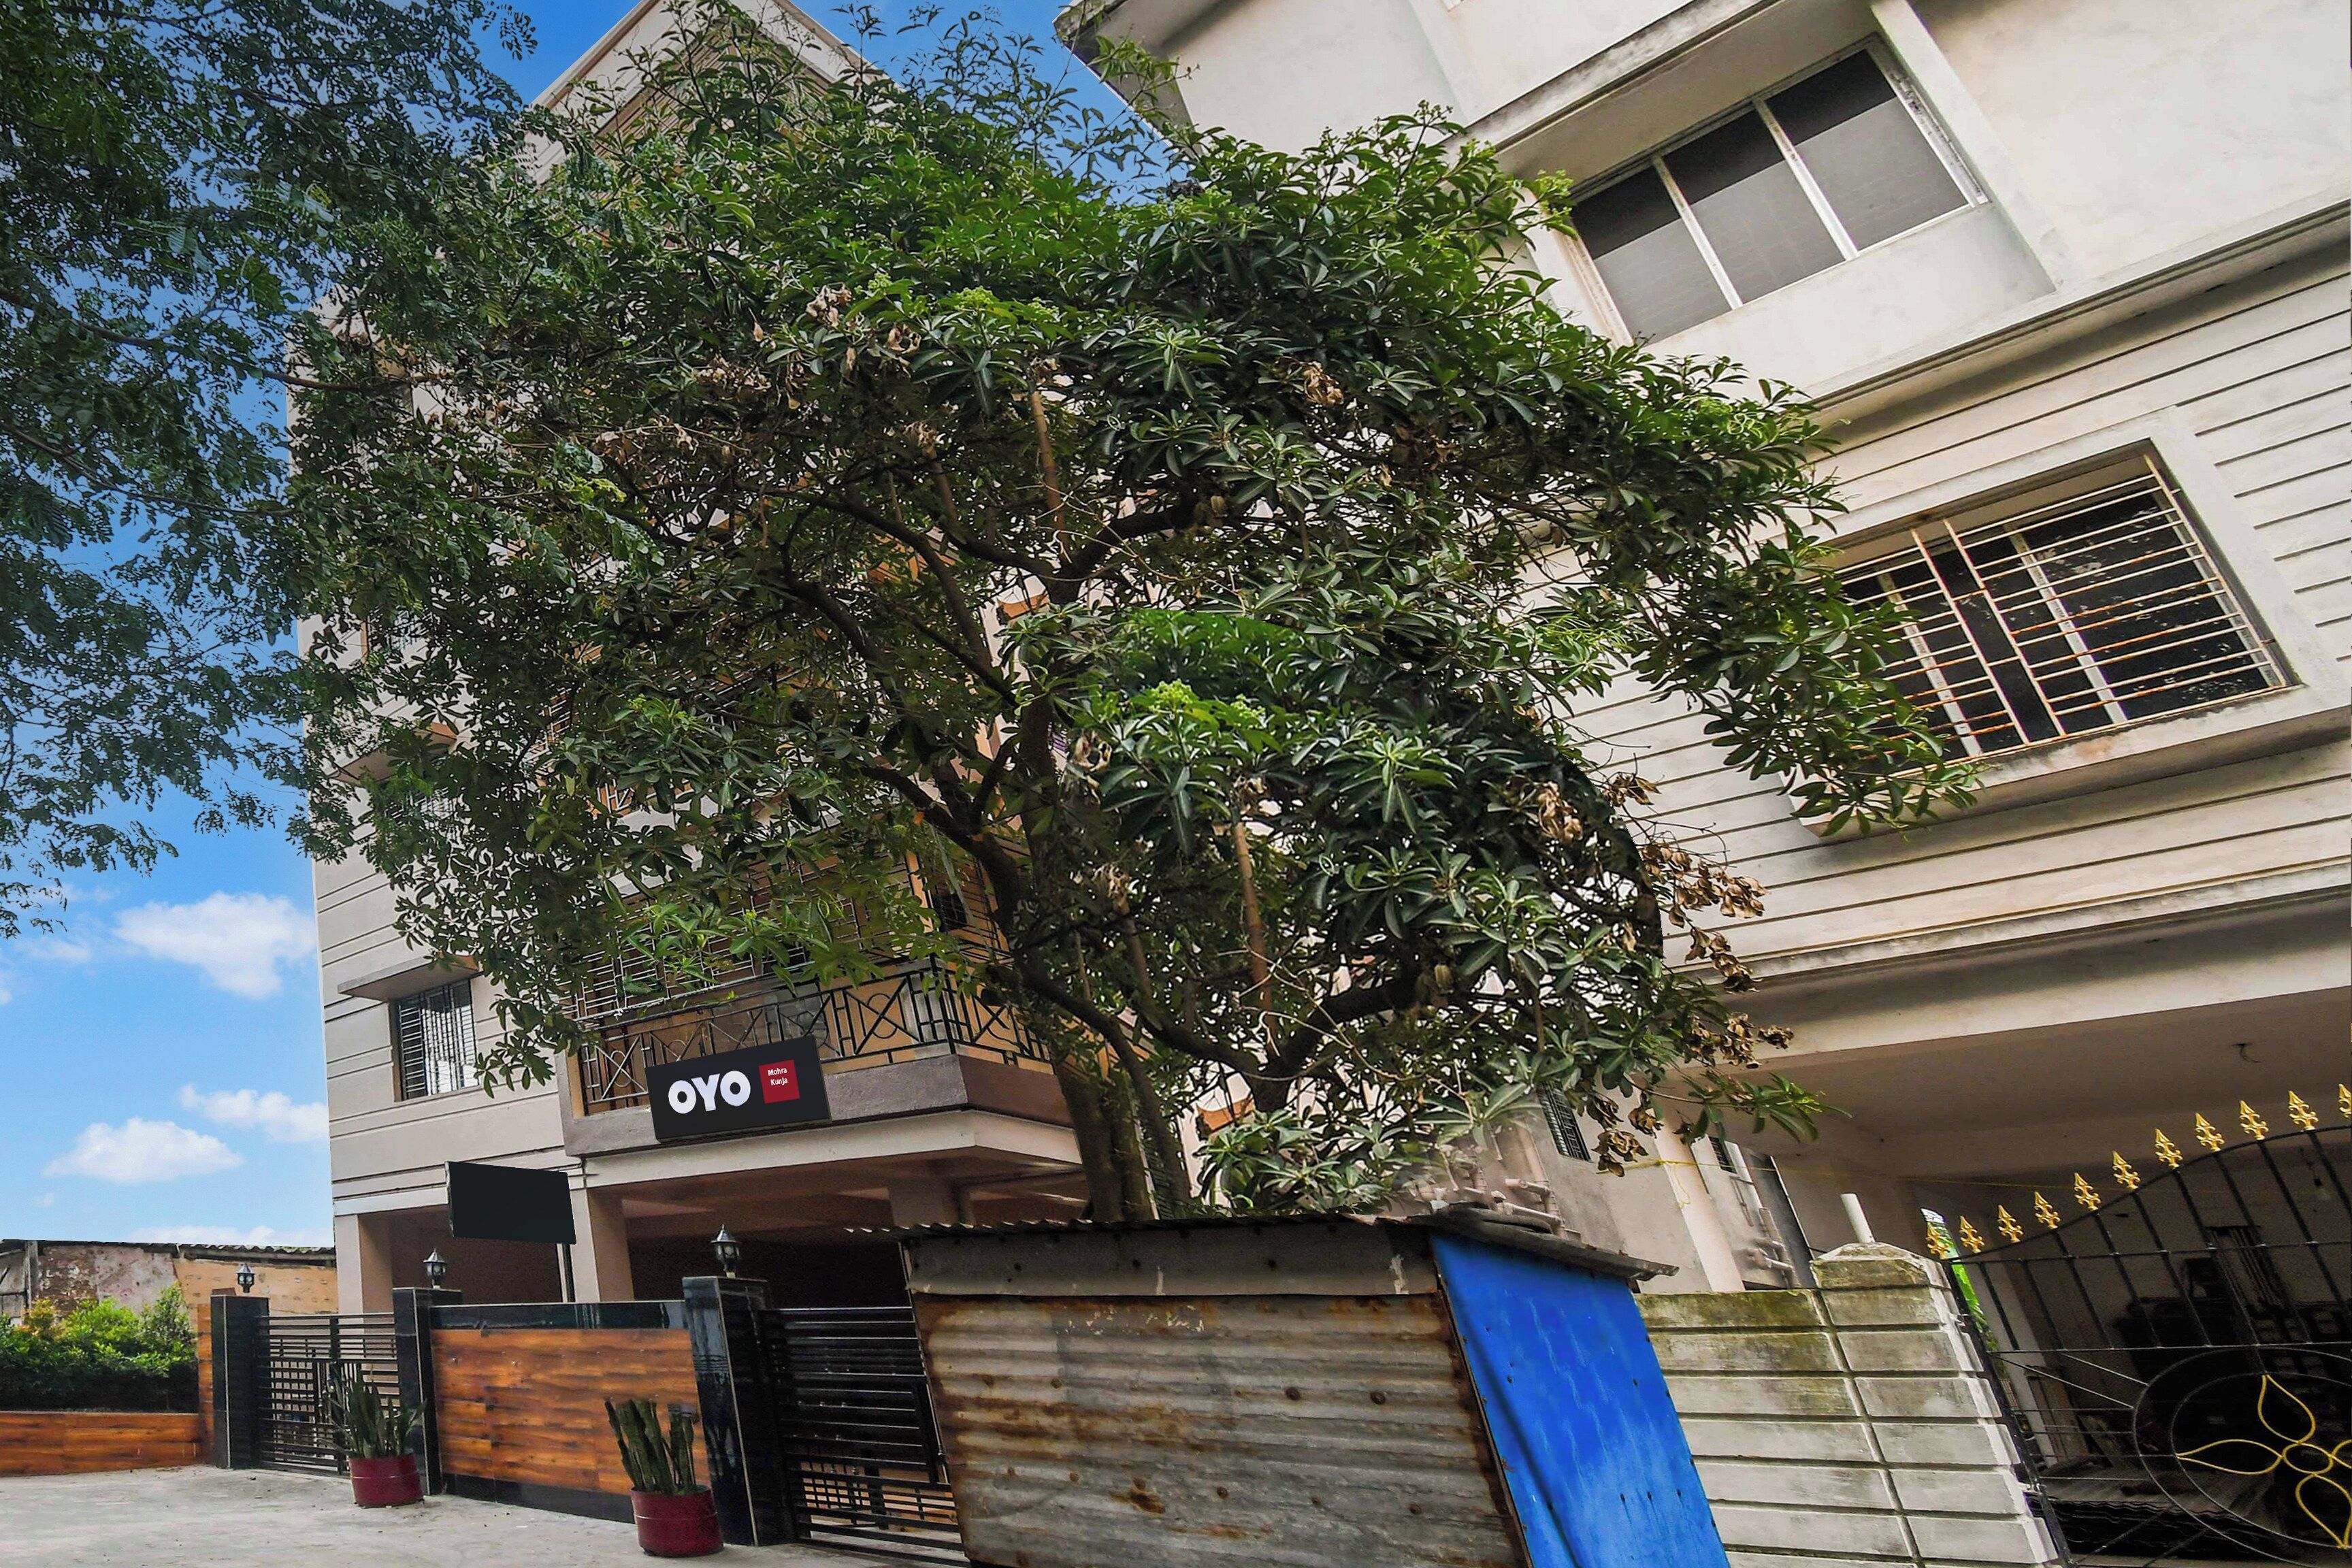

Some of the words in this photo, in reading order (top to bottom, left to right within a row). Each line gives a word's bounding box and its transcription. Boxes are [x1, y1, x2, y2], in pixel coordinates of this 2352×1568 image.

[768, 1067, 787, 1076] Mohra
[770, 1077, 788, 1086] Kunja
[668, 1071, 751, 1114] OYO
